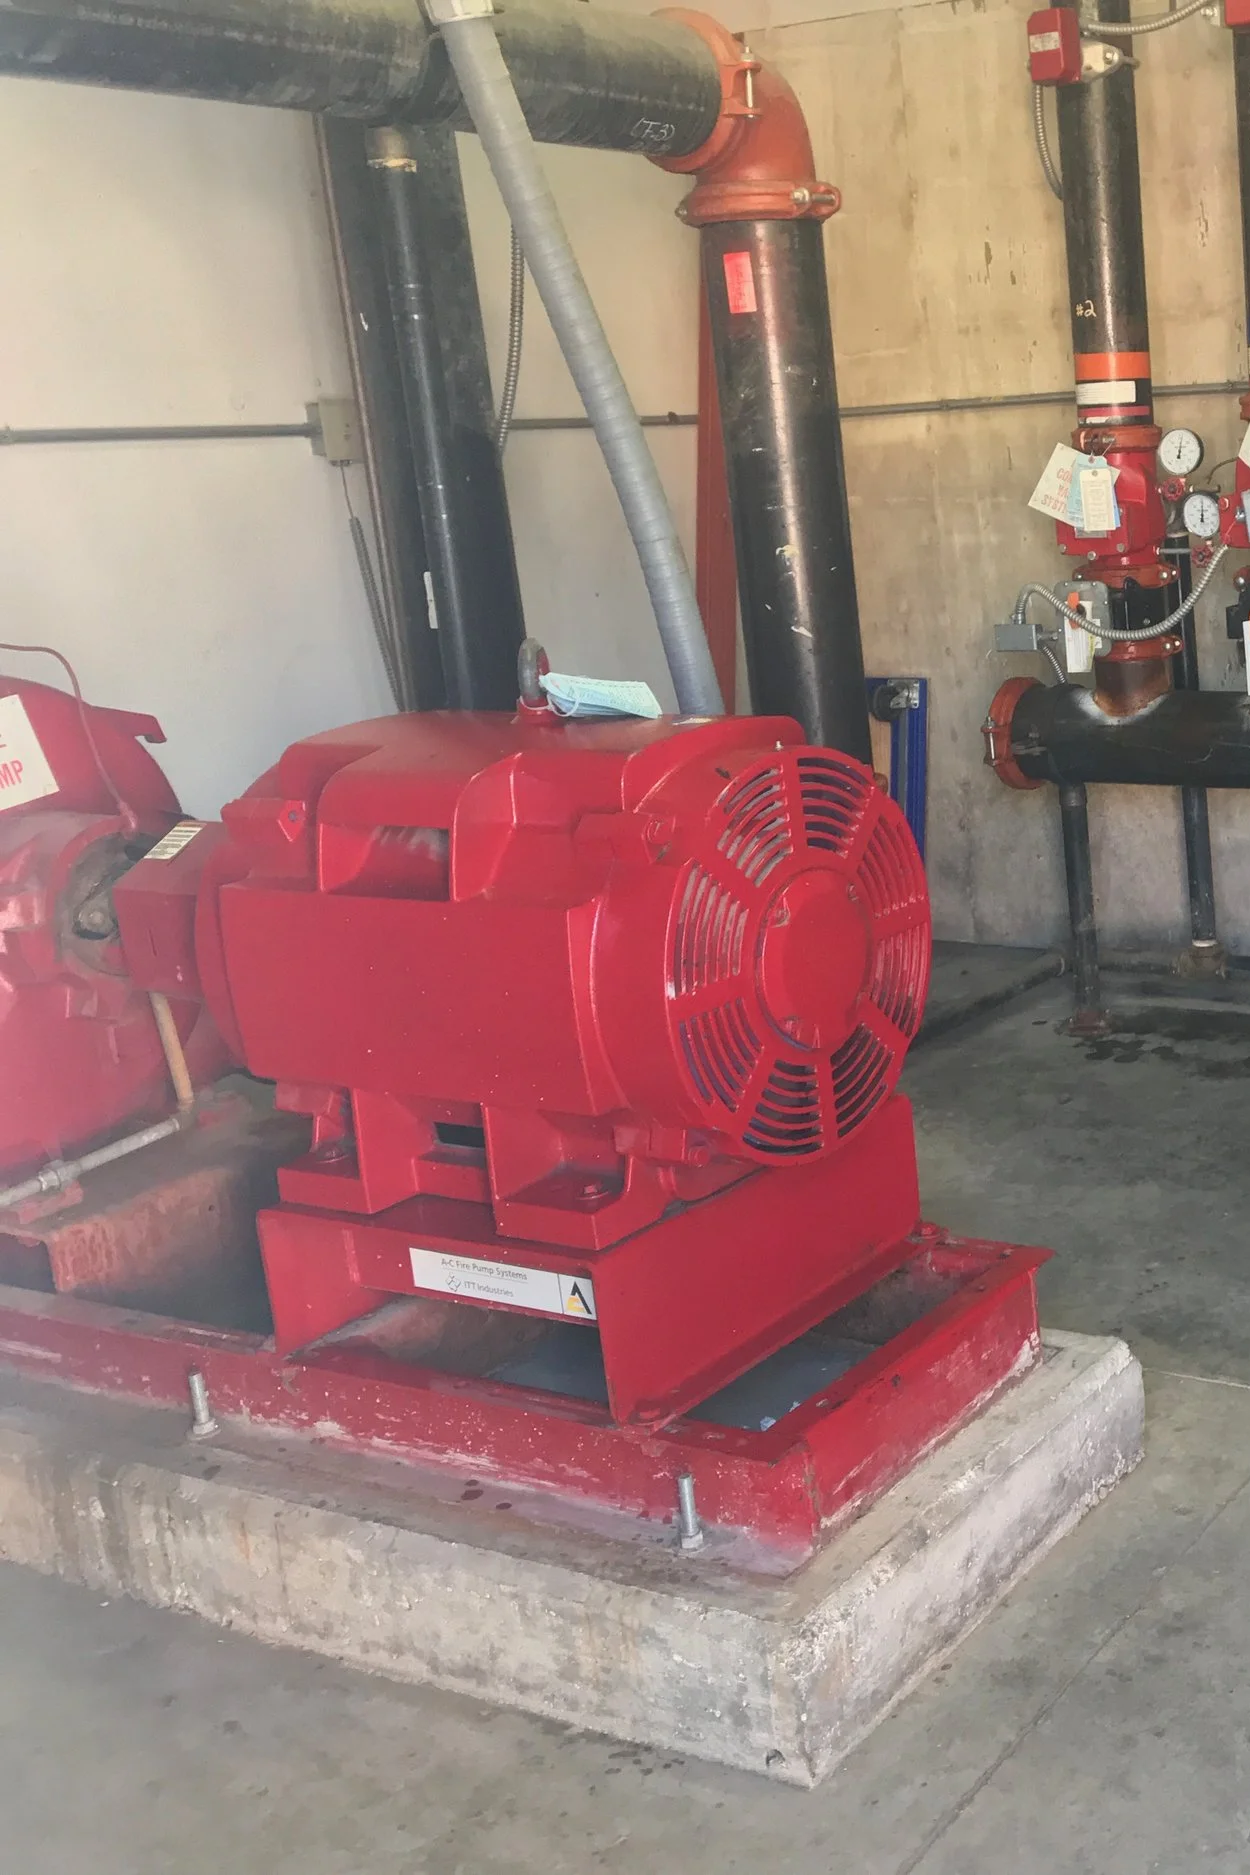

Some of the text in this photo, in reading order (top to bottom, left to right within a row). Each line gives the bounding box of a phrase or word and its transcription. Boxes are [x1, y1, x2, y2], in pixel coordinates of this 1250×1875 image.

[1075, 299, 1097, 318] #2
[456, 1259, 470, 1271] Fire
[472, 1262, 494, 1276] Pump
[496, 1266, 528, 1281] Systems
[477, 1282, 514, 1298] Industries
